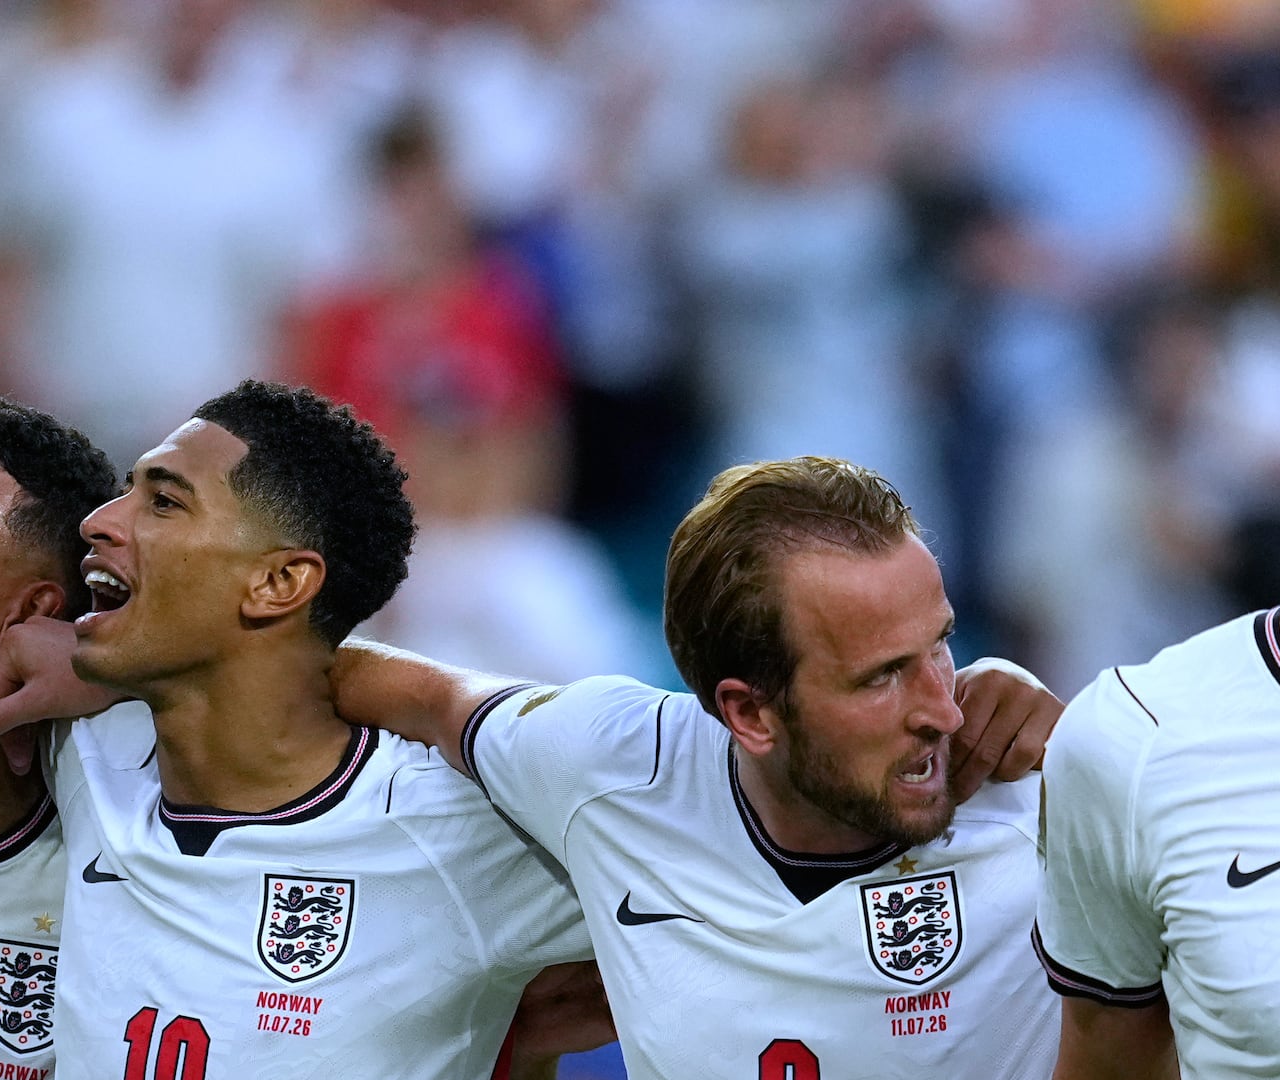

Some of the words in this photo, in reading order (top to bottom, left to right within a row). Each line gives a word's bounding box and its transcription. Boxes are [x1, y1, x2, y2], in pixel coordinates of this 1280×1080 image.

[256, 991, 324, 1015] NORWAY
[884, 991, 951, 1014] NORWAY
[257, 1013, 312, 1037] 11.07.26
[891, 1014, 947, 1036] 11.07.26
